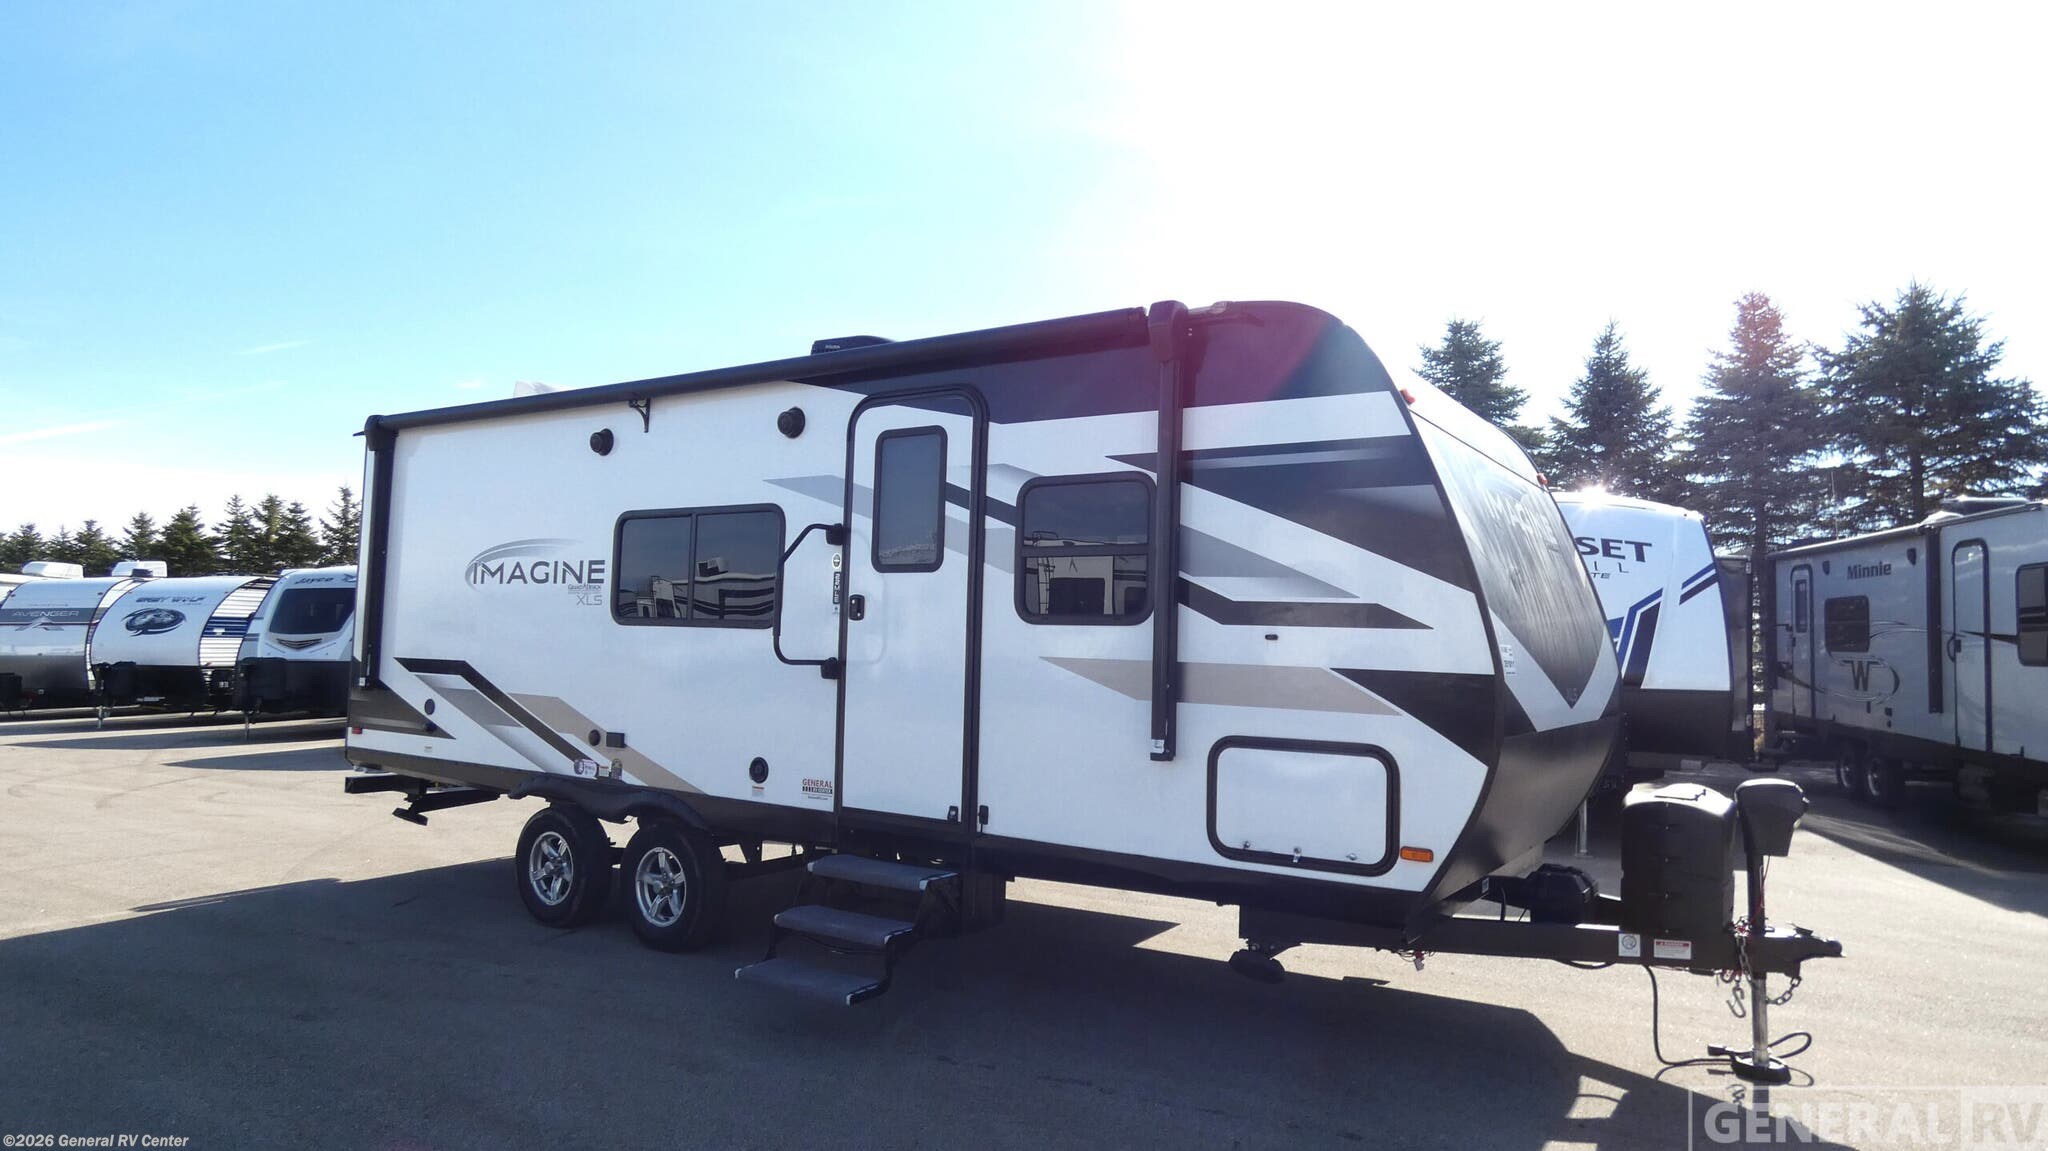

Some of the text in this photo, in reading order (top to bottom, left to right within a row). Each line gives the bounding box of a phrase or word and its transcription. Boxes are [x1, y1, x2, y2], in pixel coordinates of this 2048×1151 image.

[1574, 537, 1653, 563] SET
[473, 560, 605, 585] IMAGINE
[1847, 561, 1892, 580] Minnie
[576, 595, 603, 606] XLS
[802, 778, 833, 789] GENERAL
